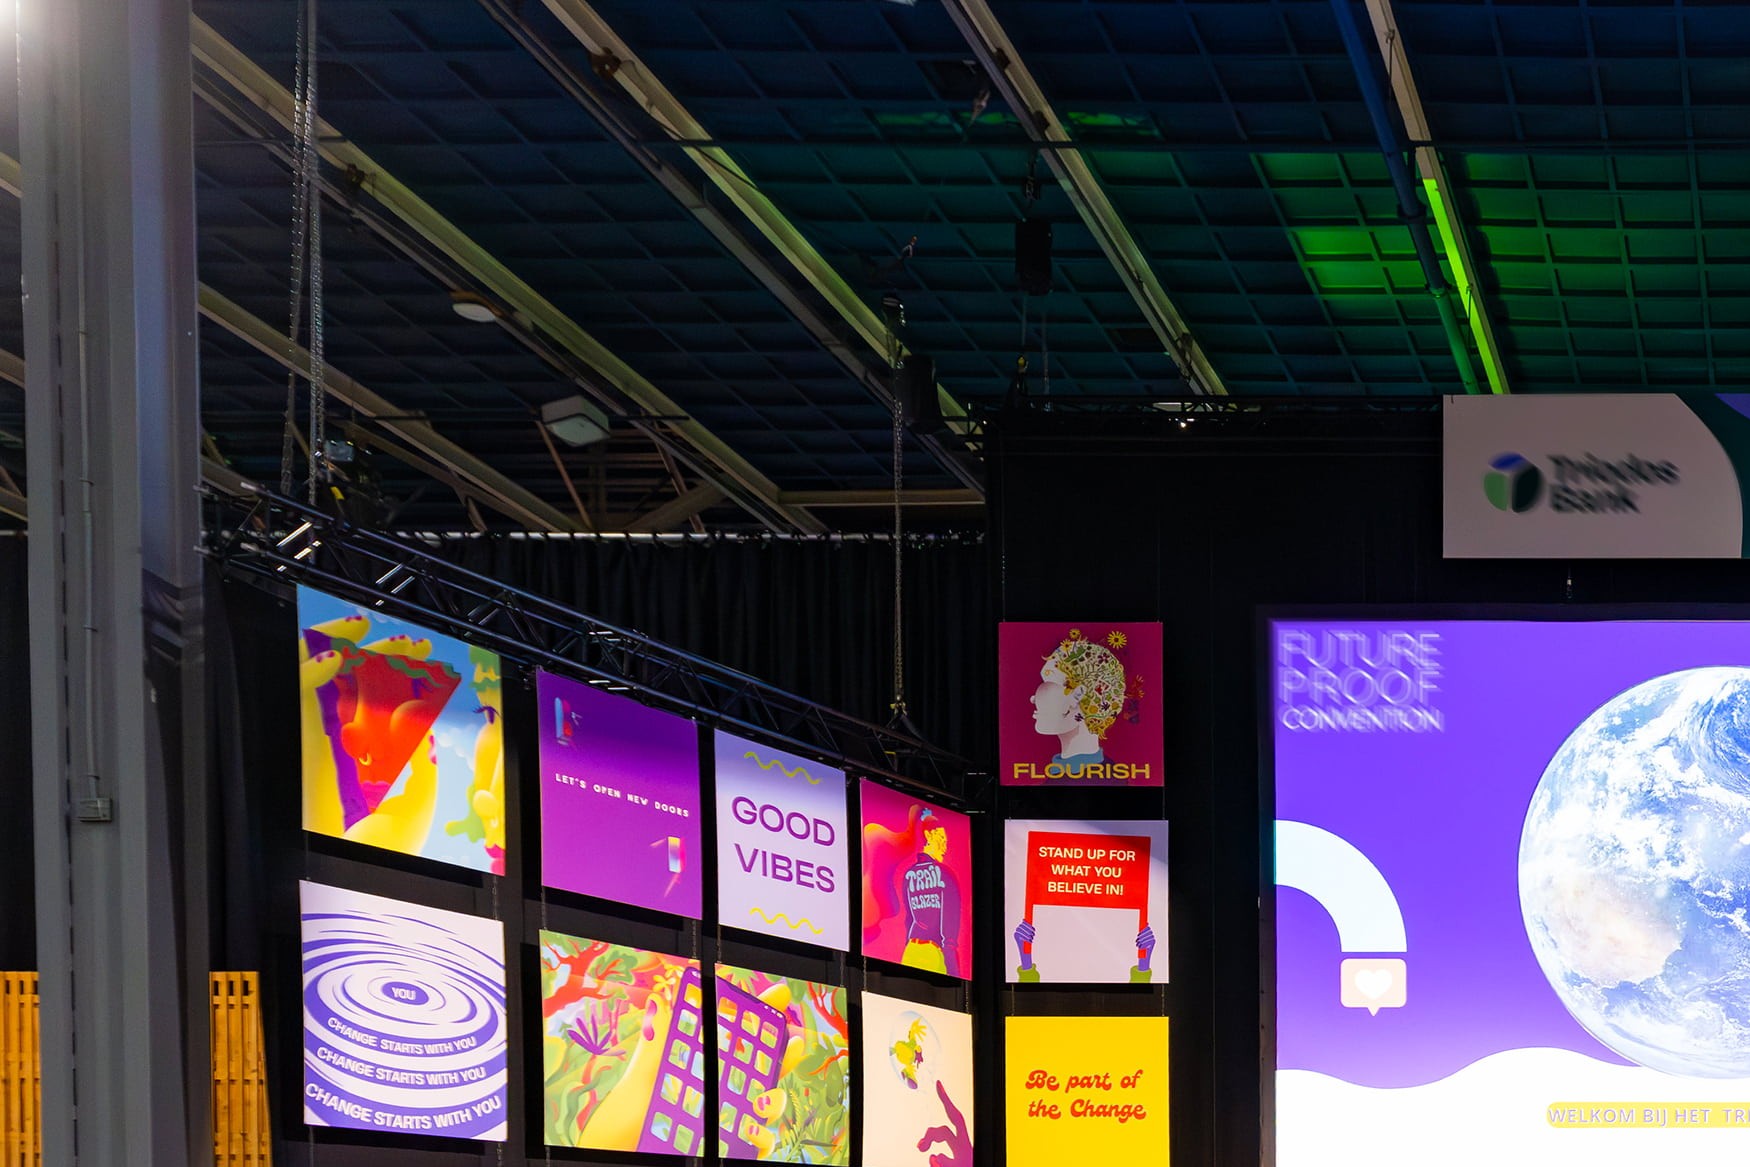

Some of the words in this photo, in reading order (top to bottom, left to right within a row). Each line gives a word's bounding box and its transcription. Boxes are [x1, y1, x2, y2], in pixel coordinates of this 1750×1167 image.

[1278, 630, 1443, 669] FUTURE
[1278, 668, 1441, 705] PROOF
[1279, 705, 1444, 732] CONVENTION
[1013, 763, 1150, 779] FLOURISH
[593, 784, 621, 799] OPEN
[627, 793, 649, 806] NEW
[731, 796, 836, 847] GOOD
[1038, 846, 1083, 859] STAND
[1087, 849, 1106, 860] UP
[1109, 850, 1136, 861] FOR
[734, 843, 836, 894] VIBES
[1051, 864, 1091, 877] WHAT
[1094, 866, 1122, 878] YOU
[1048, 882, 1102, 894] BELIEVE
[1105, 884, 1124, 895] IN!
[391, 987, 416, 1000] YOU
[327, 1017, 378, 1046] CHANGE
[380, 1039, 423, 1055] STARTS
[424, 1041, 453, 1055] WITH
[453, 1036, 477, 1050] YOU
[316, 1046, 375, 1077] CHANGE
[376, 1069, 425, 1085] STARTS
[425, 1071, 460, 1085] WITH
[460, 1066, 487, 1081] YOU
[1025, 1069, 1060, 1091] Be
[1065, 1071, 1112, 1093] part
[1120, 1069, 1144, 1088] of
[305, 1083, 373, 1122] CHANGE
[374, 1111, 432, 1129] STARTS
[433, 1110, 472, 1128] WITH
[472, 1095, 502, 1115] YOU
[1028, 1099, 1062, 1120] the
[1070, 1098, 1147, 1123] Change
[1548, 1108, 1635, 1123] WELKOM
[1643, 1108, 1668, 1127] BIJ
[1674, 1108, 1710, 1123] HET
